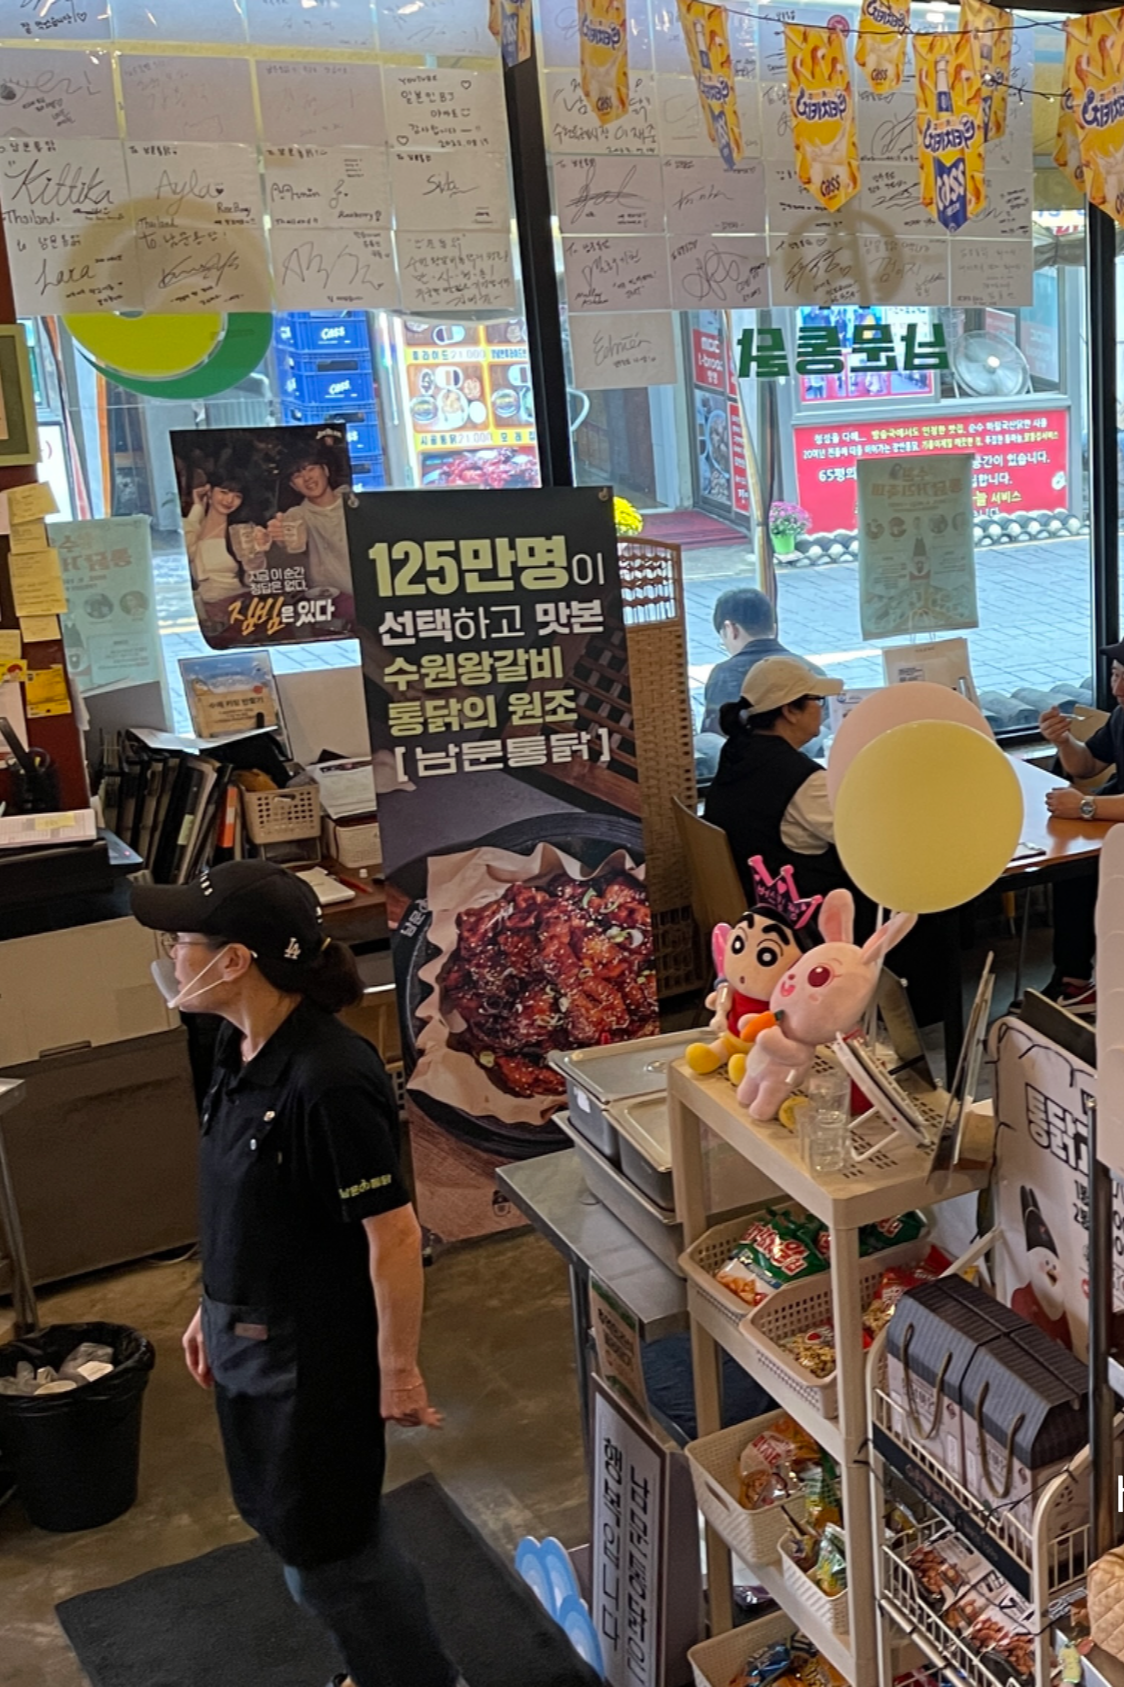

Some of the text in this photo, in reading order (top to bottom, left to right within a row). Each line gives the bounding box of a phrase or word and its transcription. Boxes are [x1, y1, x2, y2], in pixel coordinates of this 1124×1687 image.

[368, 535, 606, 598] 125만명이
[296, 598, 336, 628] 있다
[378, 599, 605, 646] 선택하고 맛본
[383, 646, 564, 692] 수원왕갈비
[388, 689, 579, 737] 통닭의 원조
[284, 937, 302, 960] LA
